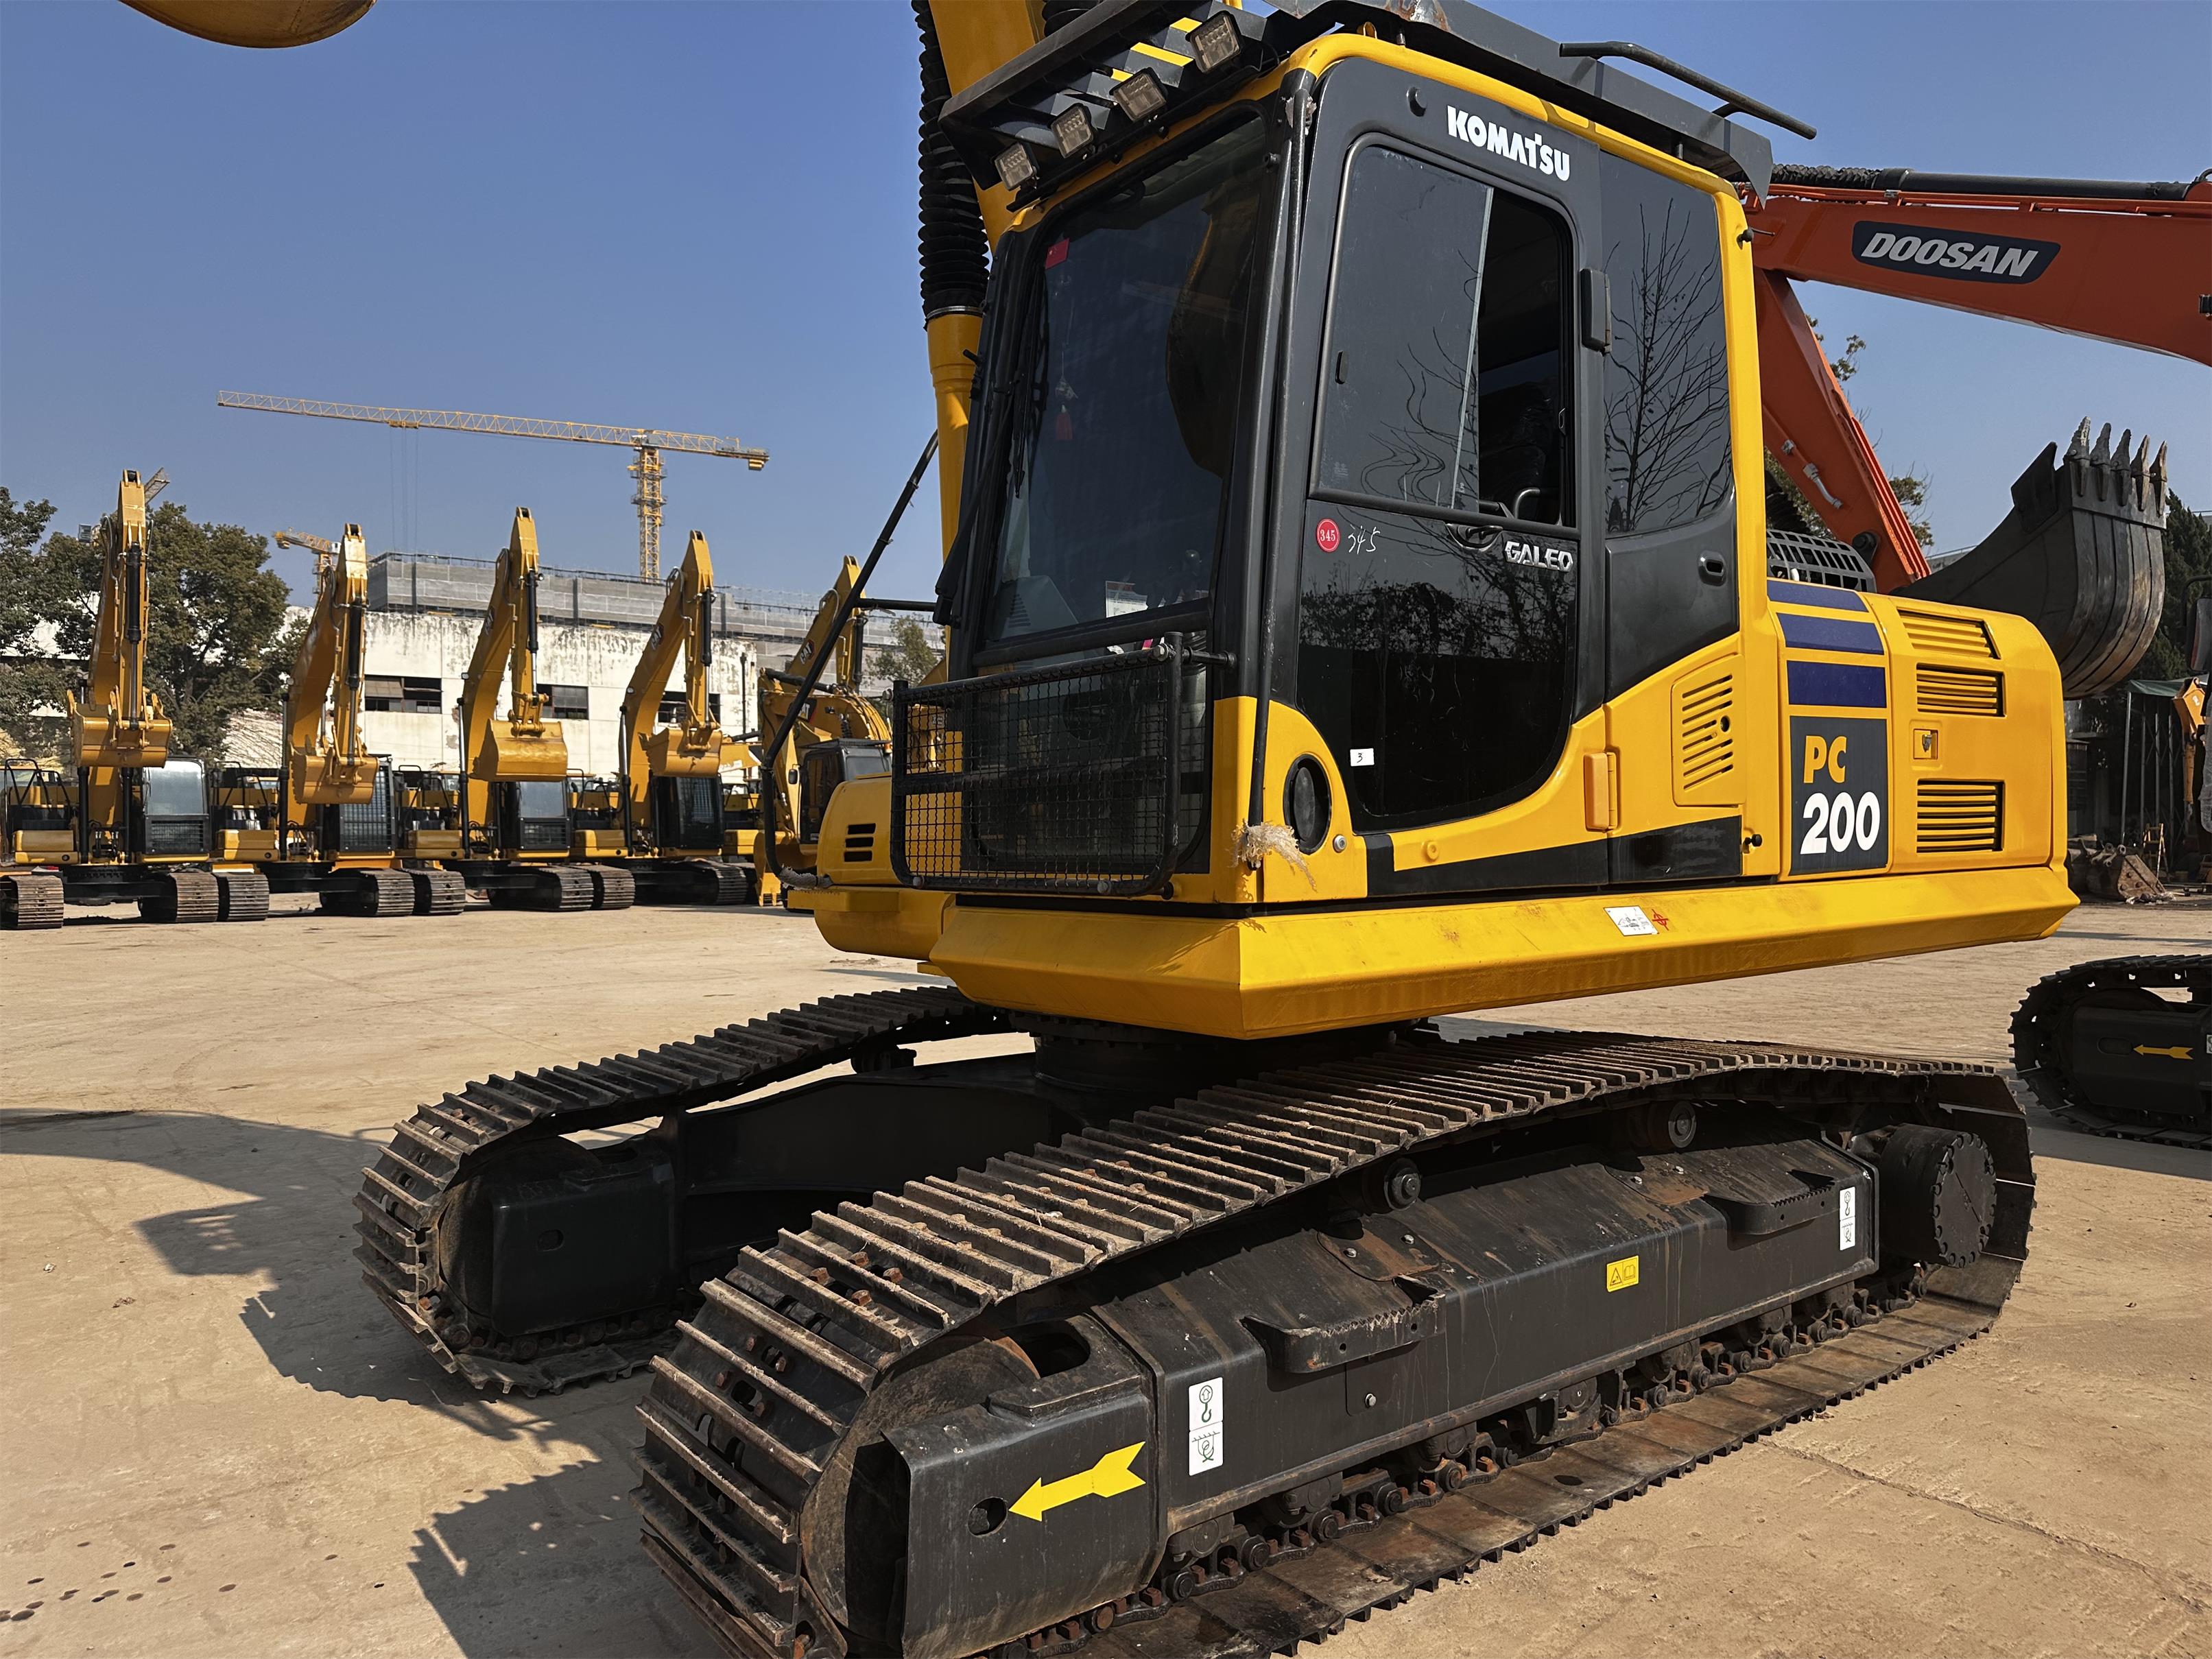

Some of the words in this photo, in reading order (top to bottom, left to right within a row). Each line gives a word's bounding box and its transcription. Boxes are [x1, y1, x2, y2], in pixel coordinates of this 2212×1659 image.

[1447, 105, 1570, 182] KOMATSU
[1861, 232, 2039, 277] DOOSAN
[1320, 529, 1336, 542] 345
[1348, 524, 1381, 555] 345
[1505, 540, 1573, 572] GALEO
[800, 641, 812, 665] CAT
[1357, 752, 1363, 763] 3
[1803, 735, 1847, 783] PC
[1800, 791, 1881, 855] 200
